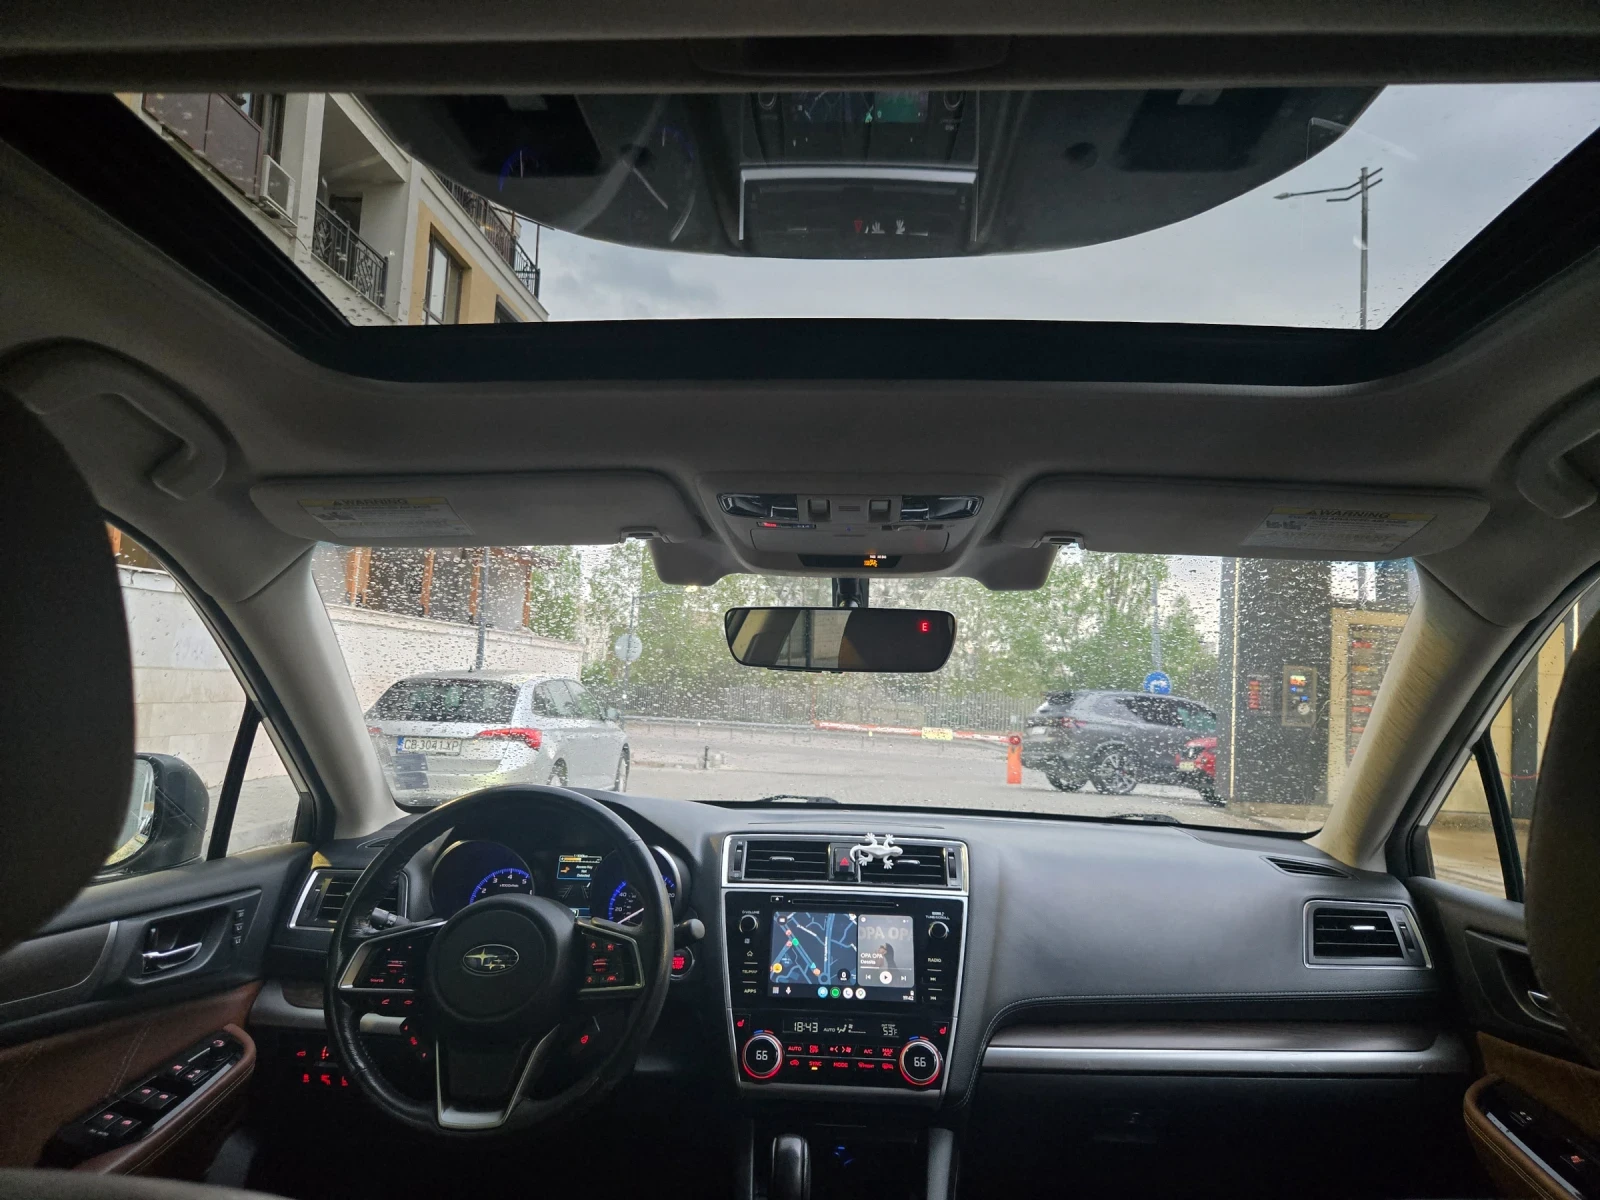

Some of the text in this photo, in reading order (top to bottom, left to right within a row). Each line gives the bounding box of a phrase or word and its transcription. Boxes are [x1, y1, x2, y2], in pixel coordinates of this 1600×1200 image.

[1319, 509, 1391, 519] WARNING
[921, 622, 928, 632] E
[793, 1021, 819, 1033] 18:43
[755, 1050, 768, 1060] 66
[913, 1056, 927, 1067] 66
